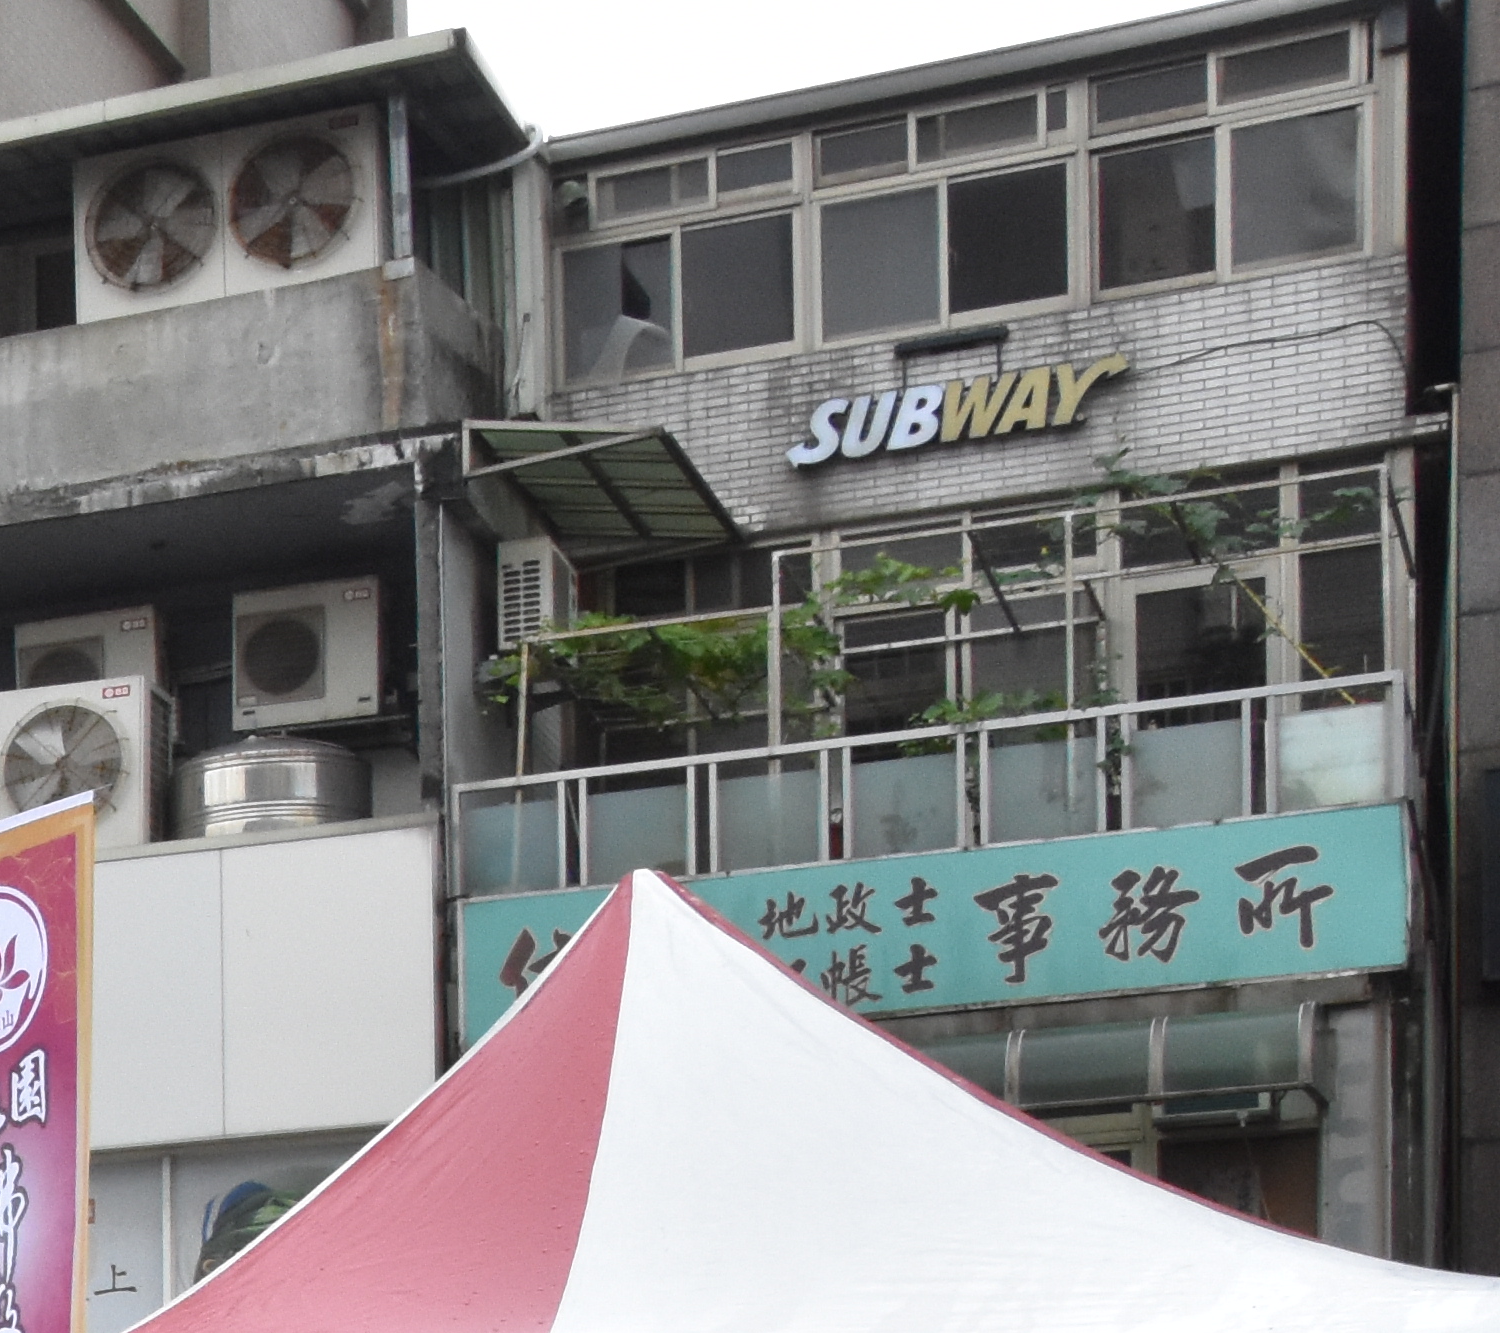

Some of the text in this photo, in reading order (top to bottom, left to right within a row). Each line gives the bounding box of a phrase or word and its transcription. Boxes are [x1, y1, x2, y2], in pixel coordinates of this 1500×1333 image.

[785, 352, 1131, 468] SUBWAY
[757, 876, 940, 941] 地政士
[973, 846, 1335, 985] 事務所
[790, 944, 939, 1007] 帳士
